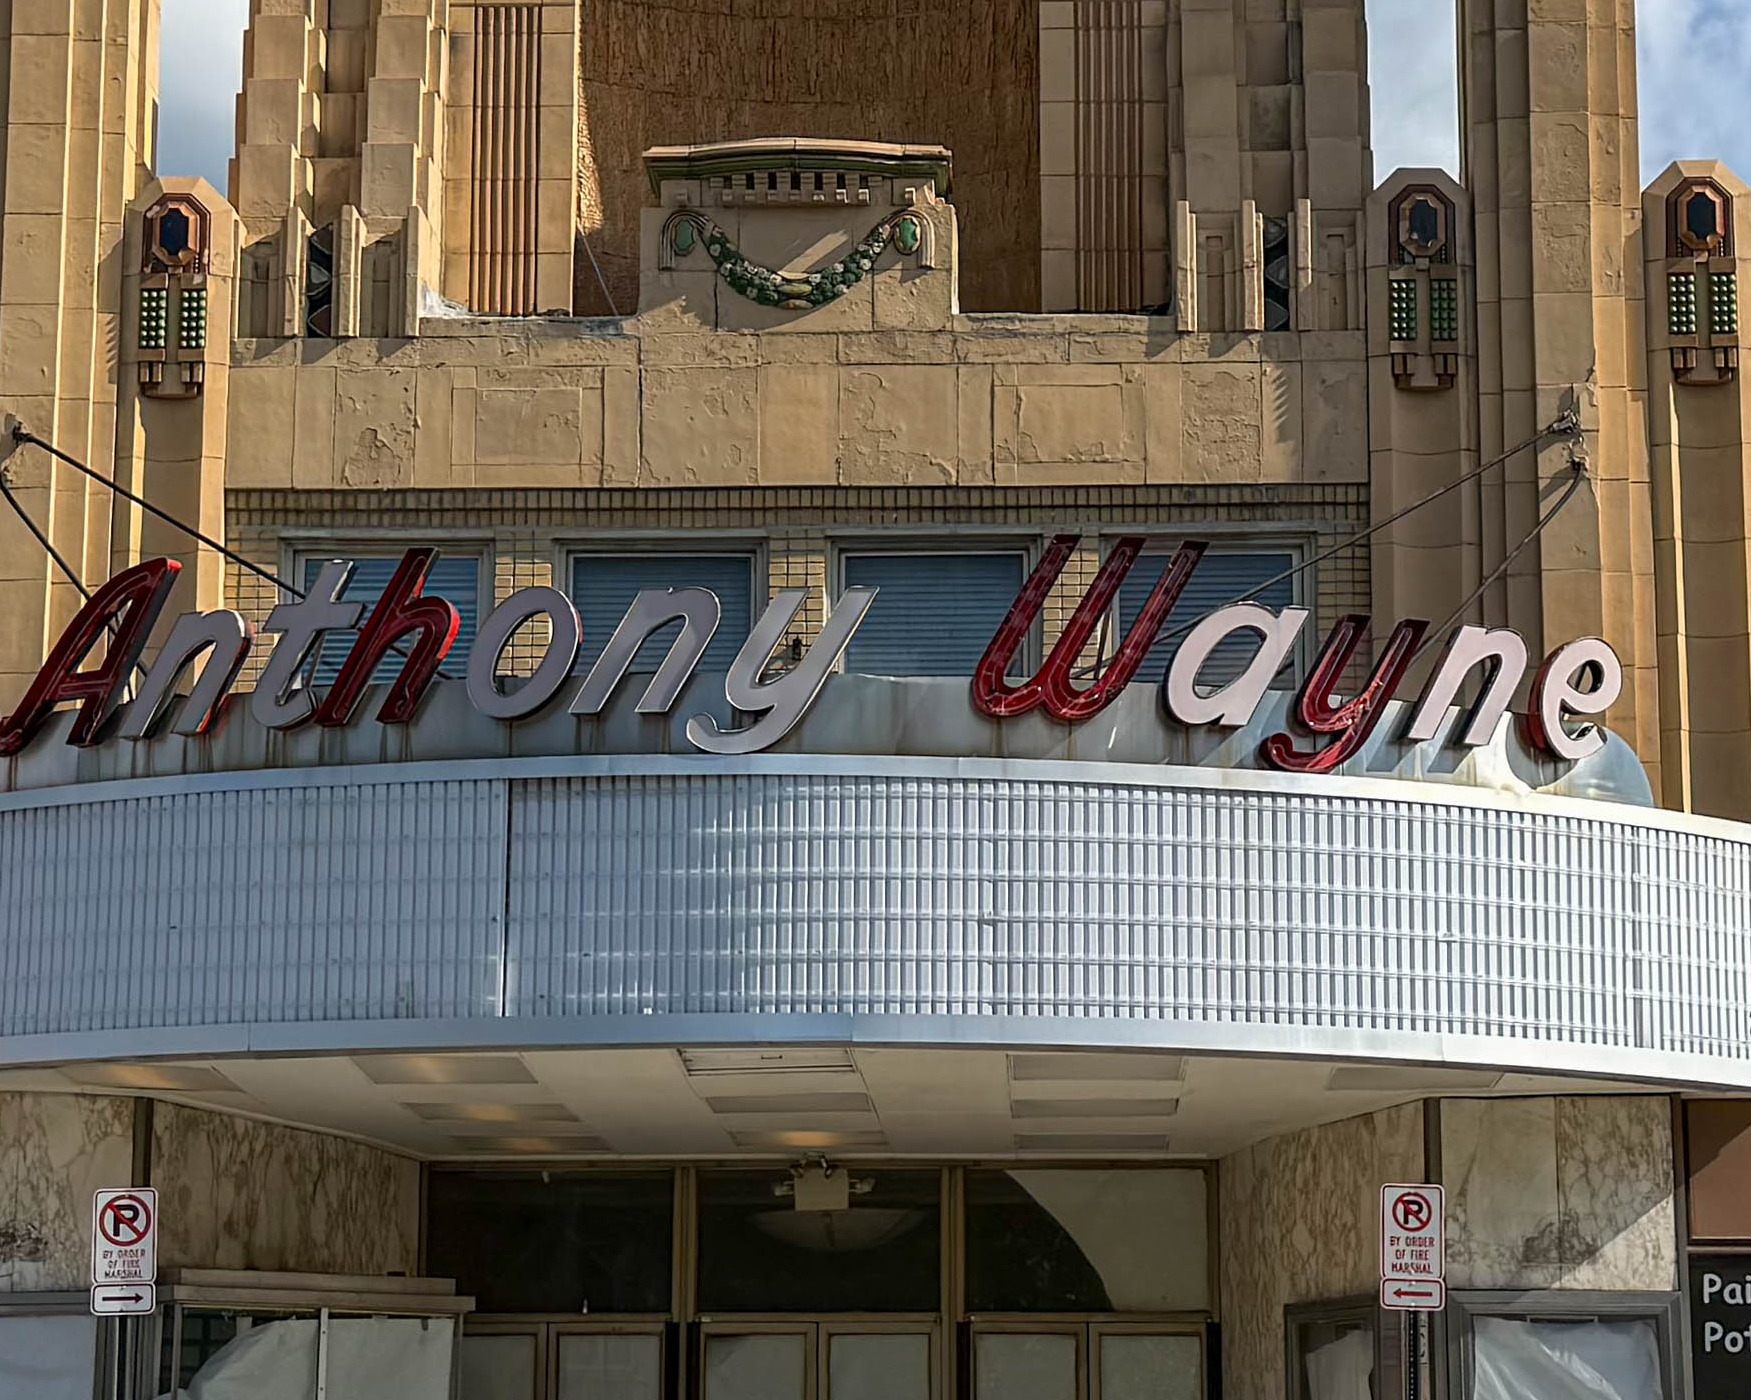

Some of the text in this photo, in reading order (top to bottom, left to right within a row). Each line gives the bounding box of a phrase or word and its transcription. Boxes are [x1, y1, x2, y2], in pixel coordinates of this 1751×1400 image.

[971, 533, 1623, 773] Wayne
[1390, 1235, 1435, 1247] BY ORDER
[1395, 1249, 1430, 1261] OF FIRE
[1391, 1262, 1433, 1274] MARSHAL
